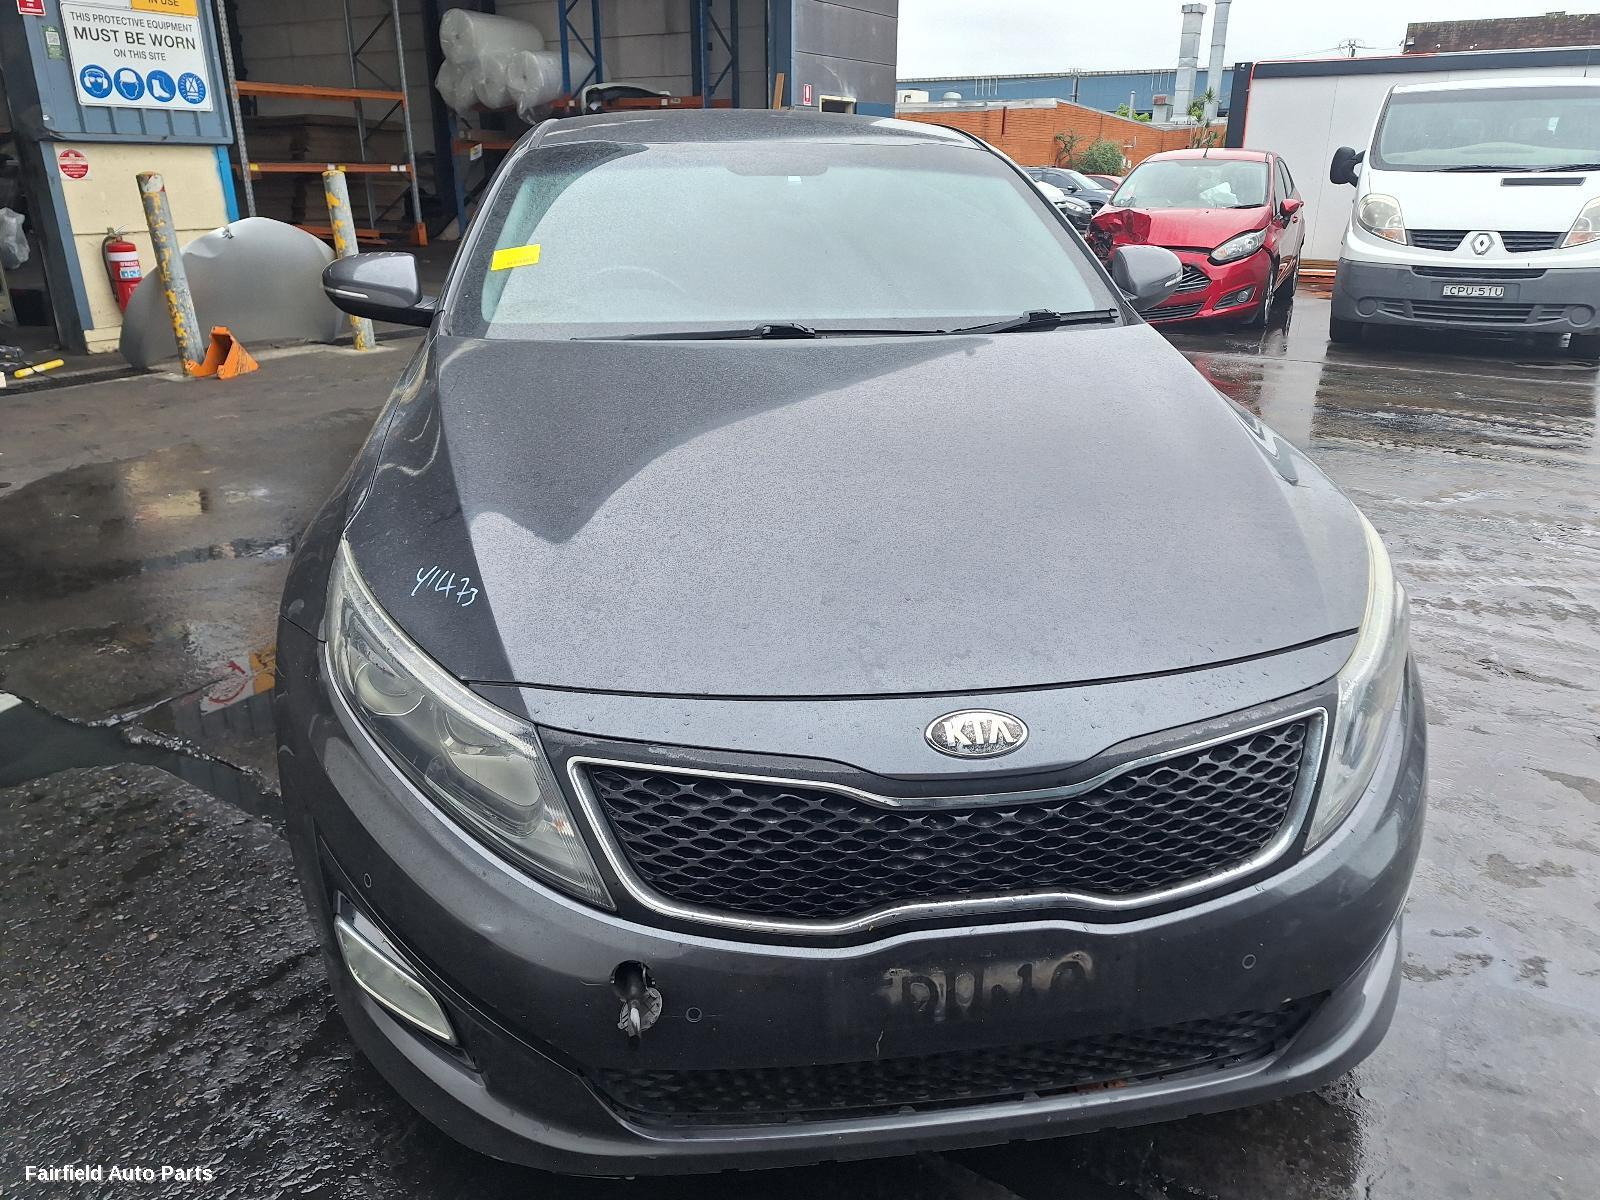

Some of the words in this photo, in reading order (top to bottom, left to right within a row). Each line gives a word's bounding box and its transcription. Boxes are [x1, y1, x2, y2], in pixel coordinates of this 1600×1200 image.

[70, 11, 91, 22] THIS
[92, 13, 145, 28] PROTECTIVE
[147, 19, 193, 33] EQUIPMENT
[73, 26, 119, 43] MUST
[125, 31, 146, 46] BE
[148, 33, 196, 50] WORN
[113, 48, 126, 58] ON
[129, 50, 147, 60] THIS
[148, 51, 167, 61] SITE
[942, 719, 1016, 747] KIA
